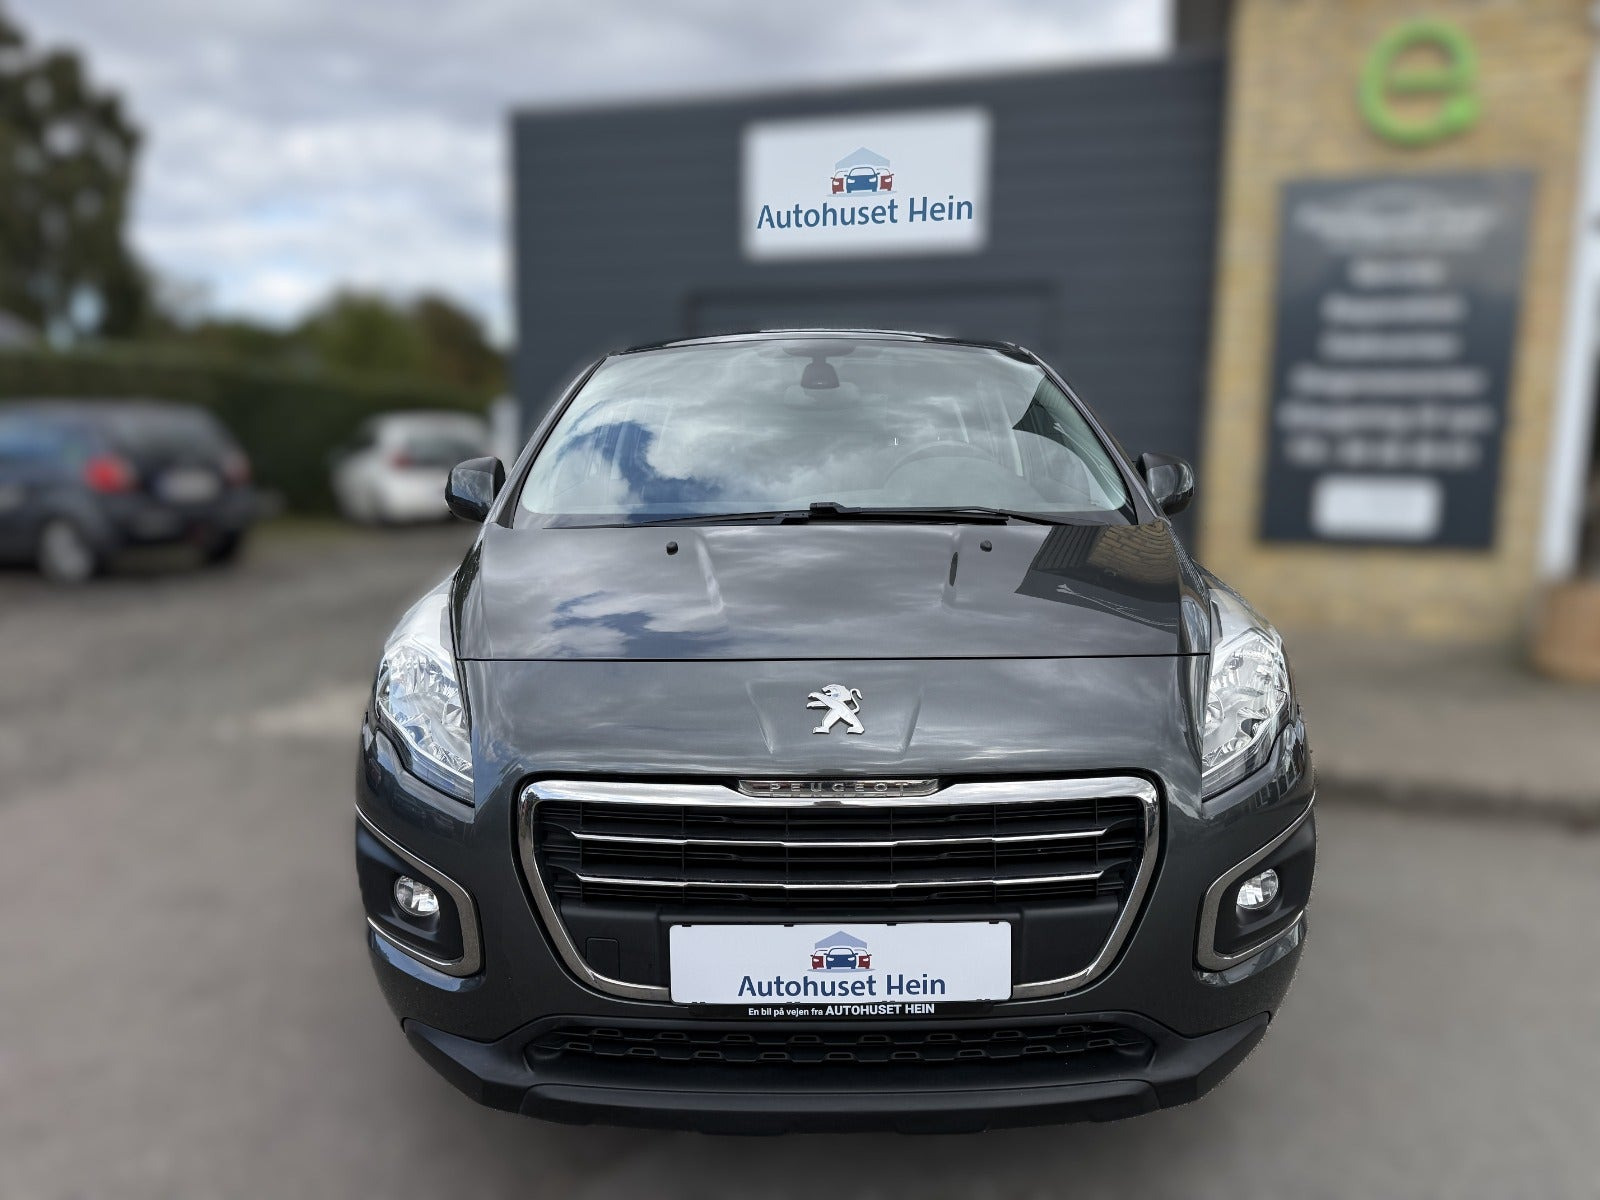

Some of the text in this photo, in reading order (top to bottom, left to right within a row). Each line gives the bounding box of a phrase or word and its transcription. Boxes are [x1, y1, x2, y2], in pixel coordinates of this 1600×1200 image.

[757, 195, 974, 229] Autohuset Hein
[769, 781, 909, 794] PEUGEOT
[737, 974, 946, 997] Autohuset Hein
[748, 1003, 935, 1018] En bil på vejen fra AUTOHUSET HEIN
